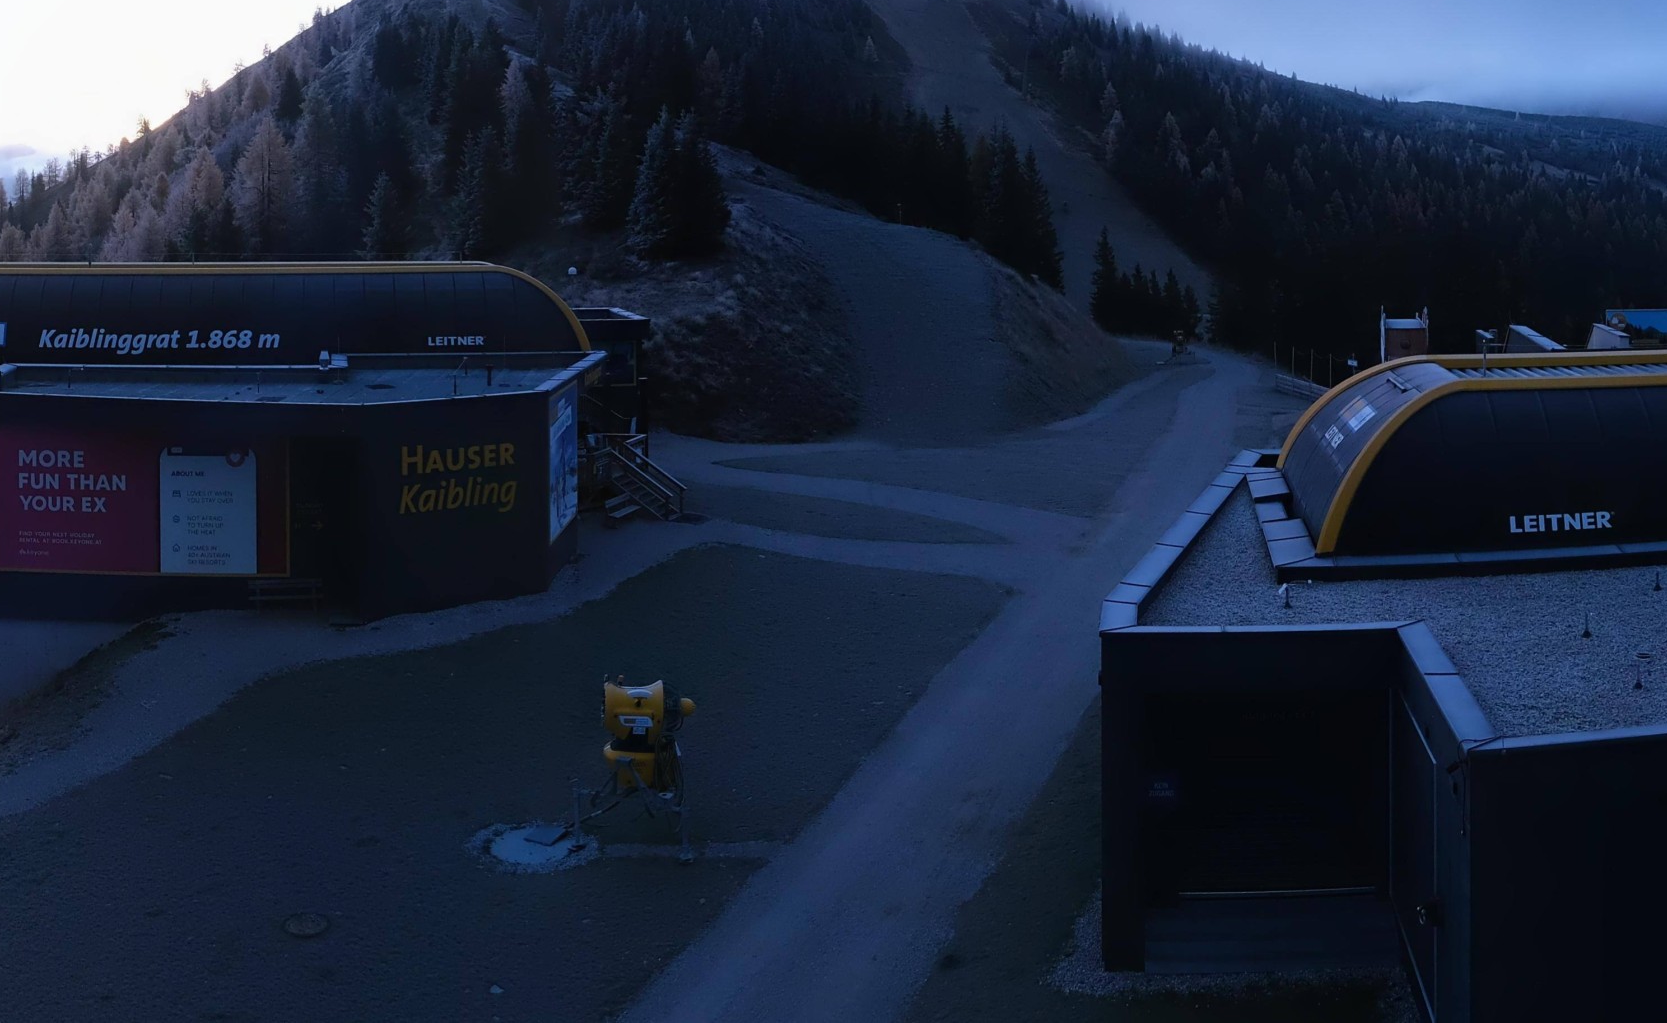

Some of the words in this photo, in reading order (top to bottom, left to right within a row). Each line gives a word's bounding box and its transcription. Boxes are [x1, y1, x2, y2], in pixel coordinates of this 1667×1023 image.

[38, 329, 181, 355] Kaiblinggrat
[186, 330, 252, 349] 1.868
[257, 333, 281, 349] m
[427, 335, 485, 346] LEITNER
[18, 449, 85, 468] MORE
[401, 442, 516, 476] HAUSER
[18, 472, 60, 490] FUN
[66, 473, 127, 491] THAN
[19, 495, 76, 512] YOUR
[81, 496, 107, 513] EX
[399, 477, 517, 514] Kaibling
[1509, 510, 1613, 534] LEITNER
